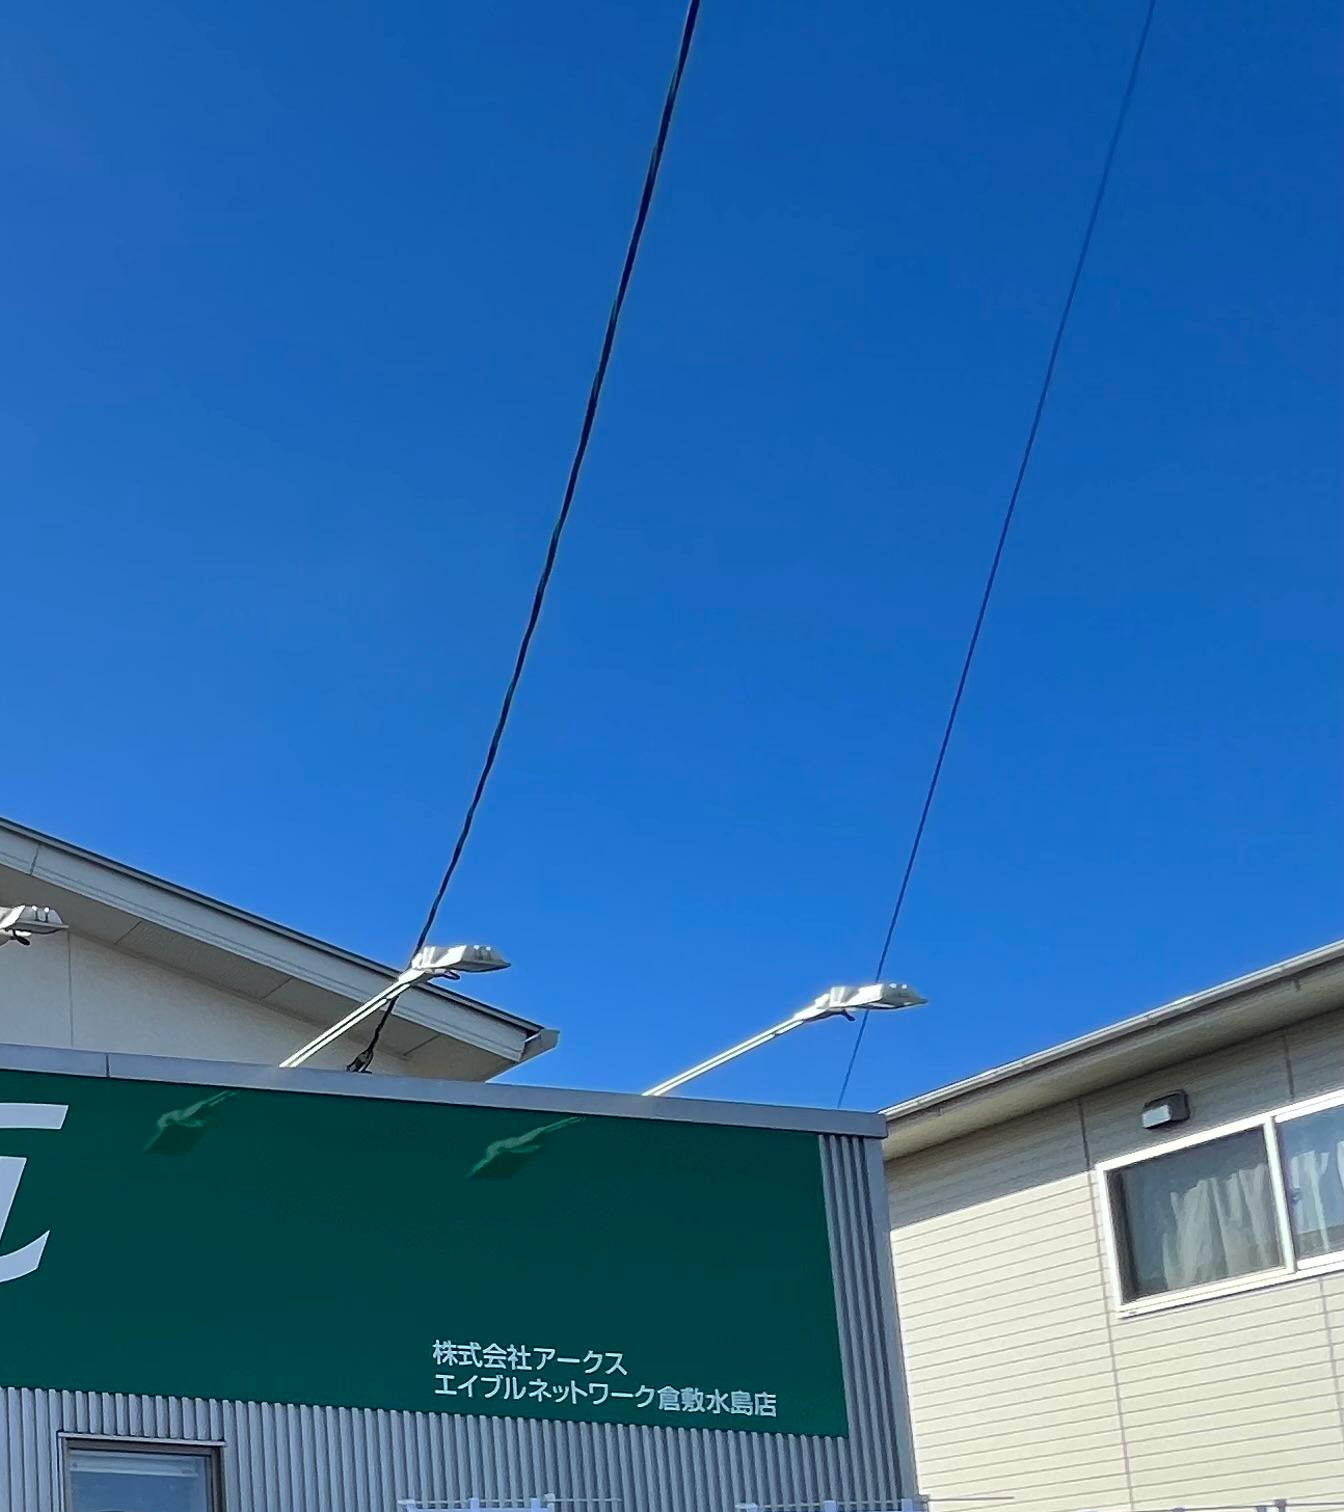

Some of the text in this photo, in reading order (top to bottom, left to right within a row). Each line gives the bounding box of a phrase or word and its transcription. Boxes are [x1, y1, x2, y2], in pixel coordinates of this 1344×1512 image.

[432, 1339, 629, 1376] 株式会社アークス
[434, 1374, 778, 1417] エイブルネットワーク倉敷水島店
